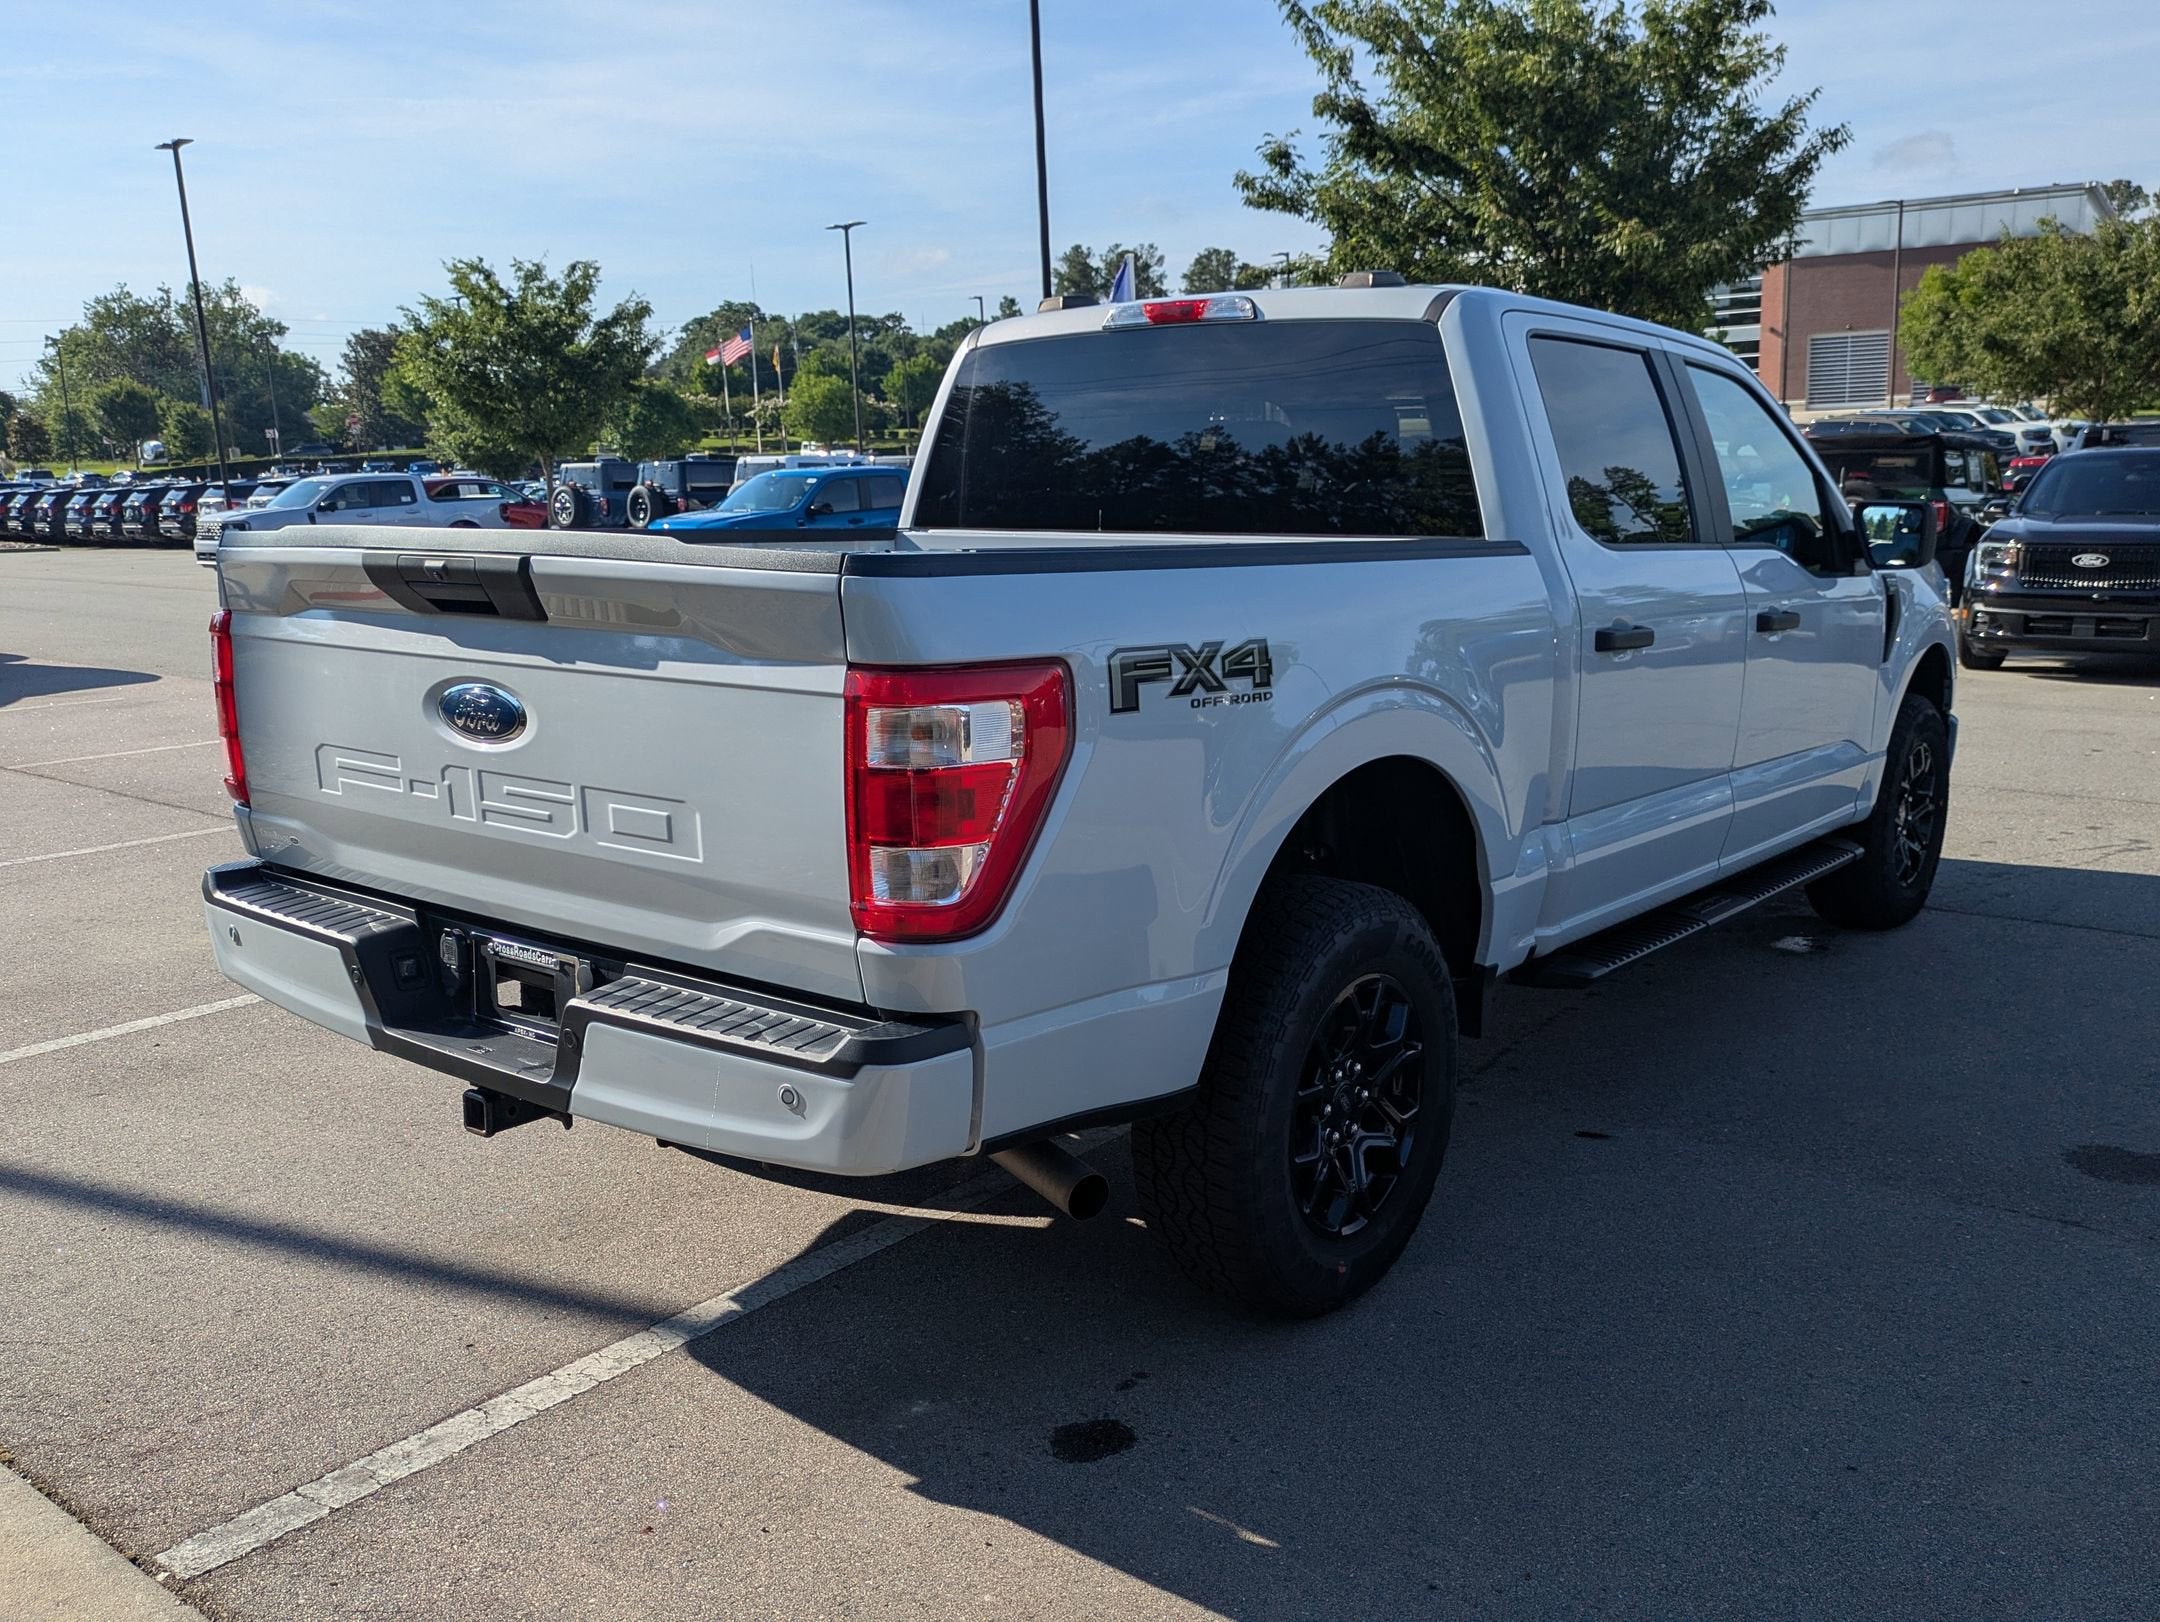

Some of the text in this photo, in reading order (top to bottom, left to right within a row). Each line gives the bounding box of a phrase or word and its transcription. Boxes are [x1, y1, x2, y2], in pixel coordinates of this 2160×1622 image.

[1106, 637, 1273, 716] FX4
[1229, 691, 1273, 706] ROAD
[453, 691, 502, 733] Ford
[314, 742, 704, 864] F-150
